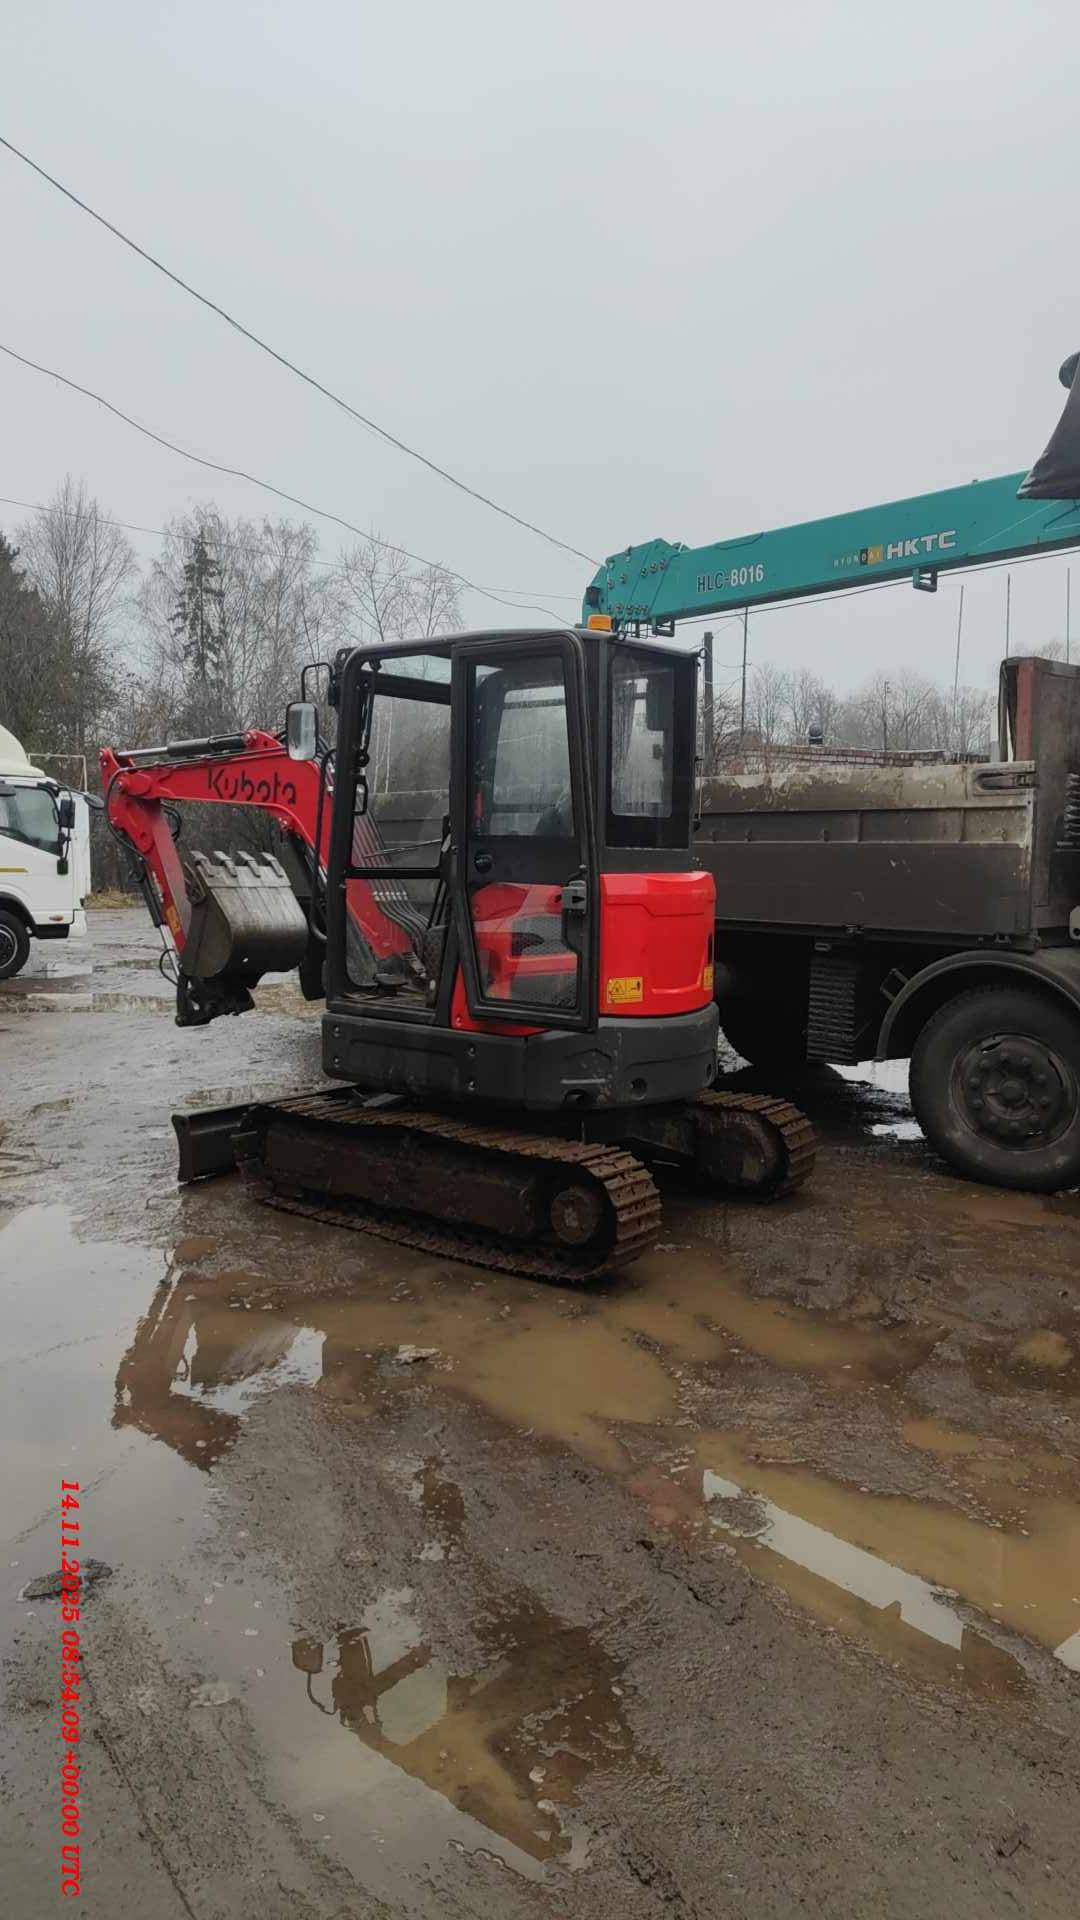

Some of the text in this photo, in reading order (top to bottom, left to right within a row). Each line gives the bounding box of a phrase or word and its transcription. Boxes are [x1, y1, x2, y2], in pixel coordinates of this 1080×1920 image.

[887, 530, 956, 560] HKTC
[697, 564, 764, 592] HLC-8016
[207, 768, 297, 805] Kubota
